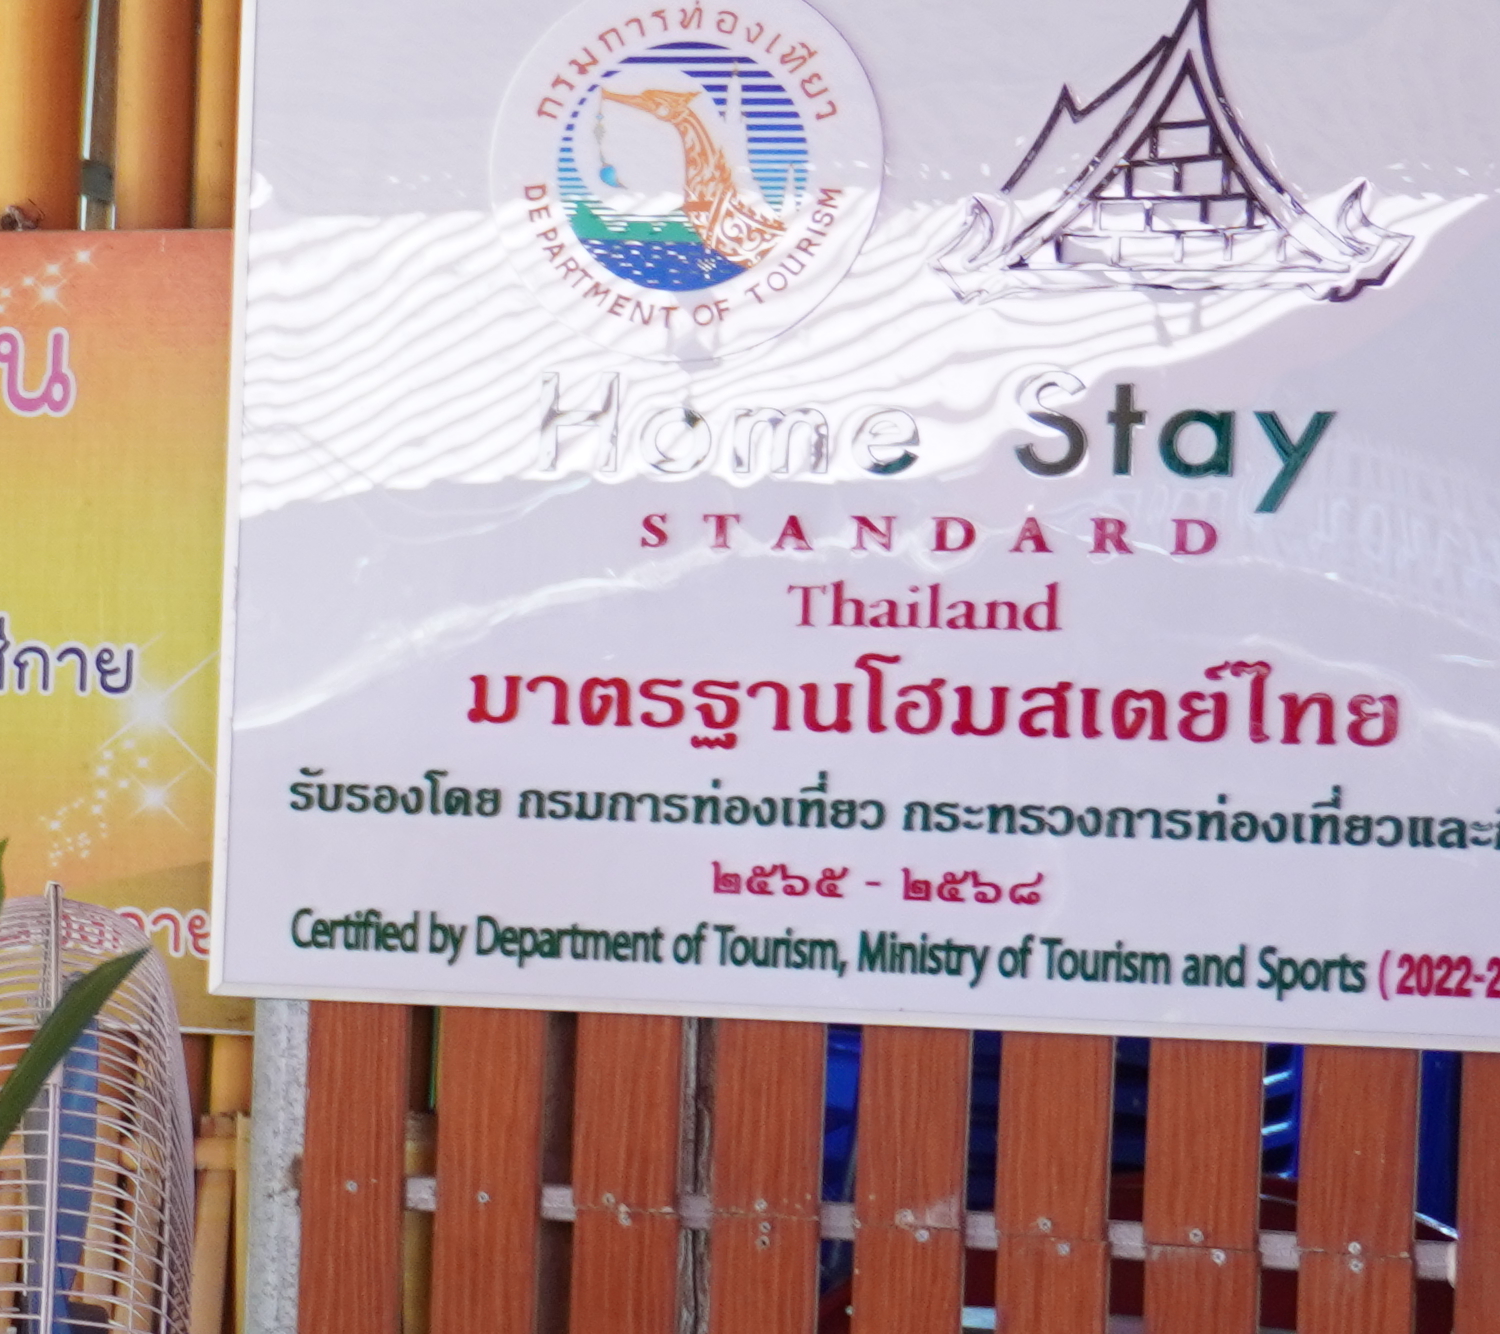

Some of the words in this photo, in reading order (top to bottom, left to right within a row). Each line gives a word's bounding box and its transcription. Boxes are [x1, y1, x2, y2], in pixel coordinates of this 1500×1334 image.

[524, 183, 680, 329] DEPARTMENT
[693, 298, 731, 327] OF
[745, 186, 843, 305] TOURISM
[540, 370, 921, 475] Home
[1015, 370, 1338, 513] Stay
[640, 512, 1219, 557] STANDARD
[788, 579, 1062, 632] Thailand
[467, 652, 1401, 750] มาตรฐานโฮมสเตย์ไทย
[289, 767, 501, 817] รับรองโดย
[518, 771, 886, 831] กรมการท่องเที่ยว
[711, 860, 850, 898] ๒๕๖๕
[902, 866, 1045, 906] ๒๕๖๘
[290, 909, 420, 954] Certified
[427, 912, 467, 965] by
[475, 914, 663, 969] Department
[673, 921, 705, 964] of
[713, 924, 848, 977] Tourism,
[858, 929, 984, 989] Ministry
[998, 935, 1035, 979] of
[1041, 938, 1172, 986] Tourism
[1182, 943, 1245, 988] and
[1257, 945, 1367, 1000] Sports
